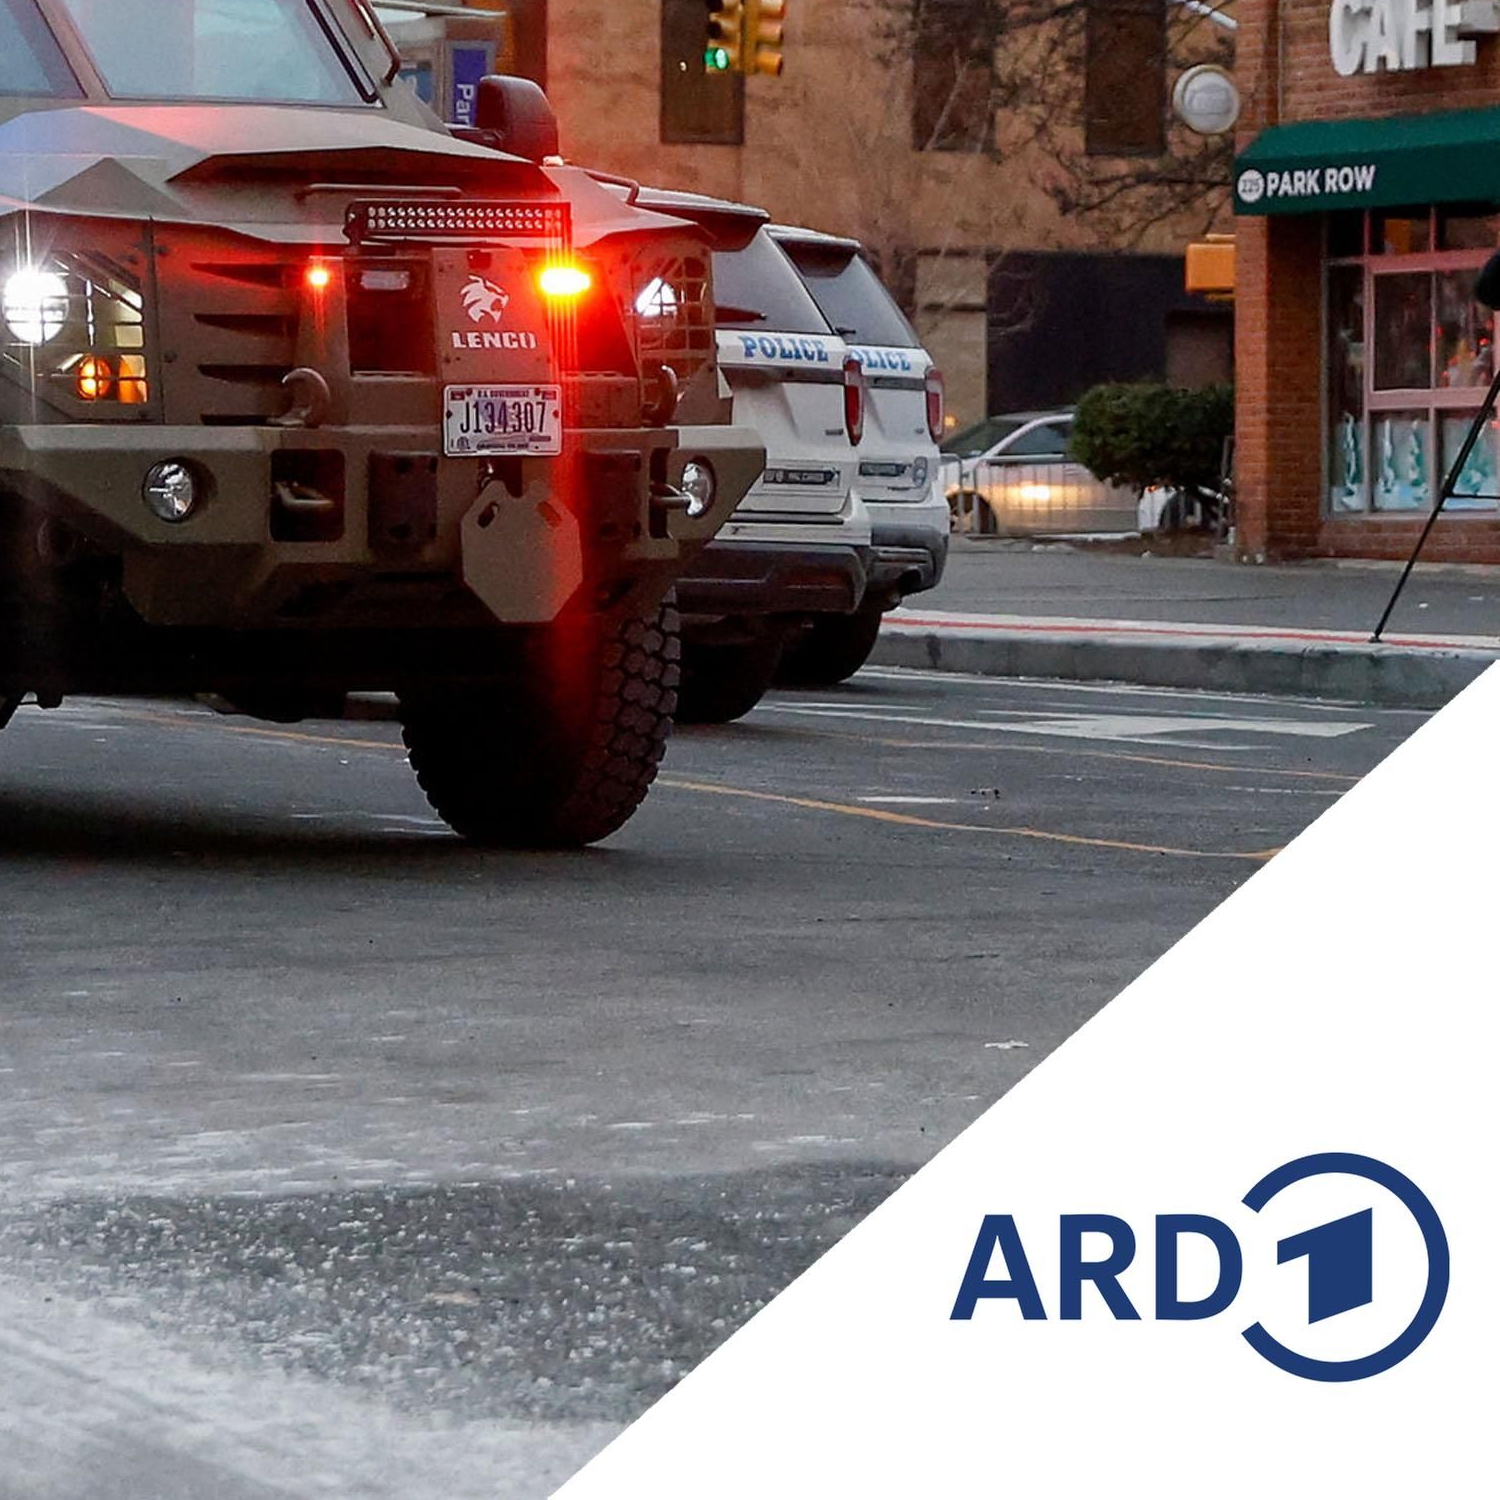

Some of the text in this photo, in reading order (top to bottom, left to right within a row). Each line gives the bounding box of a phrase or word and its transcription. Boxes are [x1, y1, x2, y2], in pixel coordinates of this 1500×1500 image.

[1266, 169, 1321, 197] PARK
[1324, 165, 1376, 193] ROW
[452, 332, 537, 349] LENCO
[739, 335, 829, 362] POLICE
